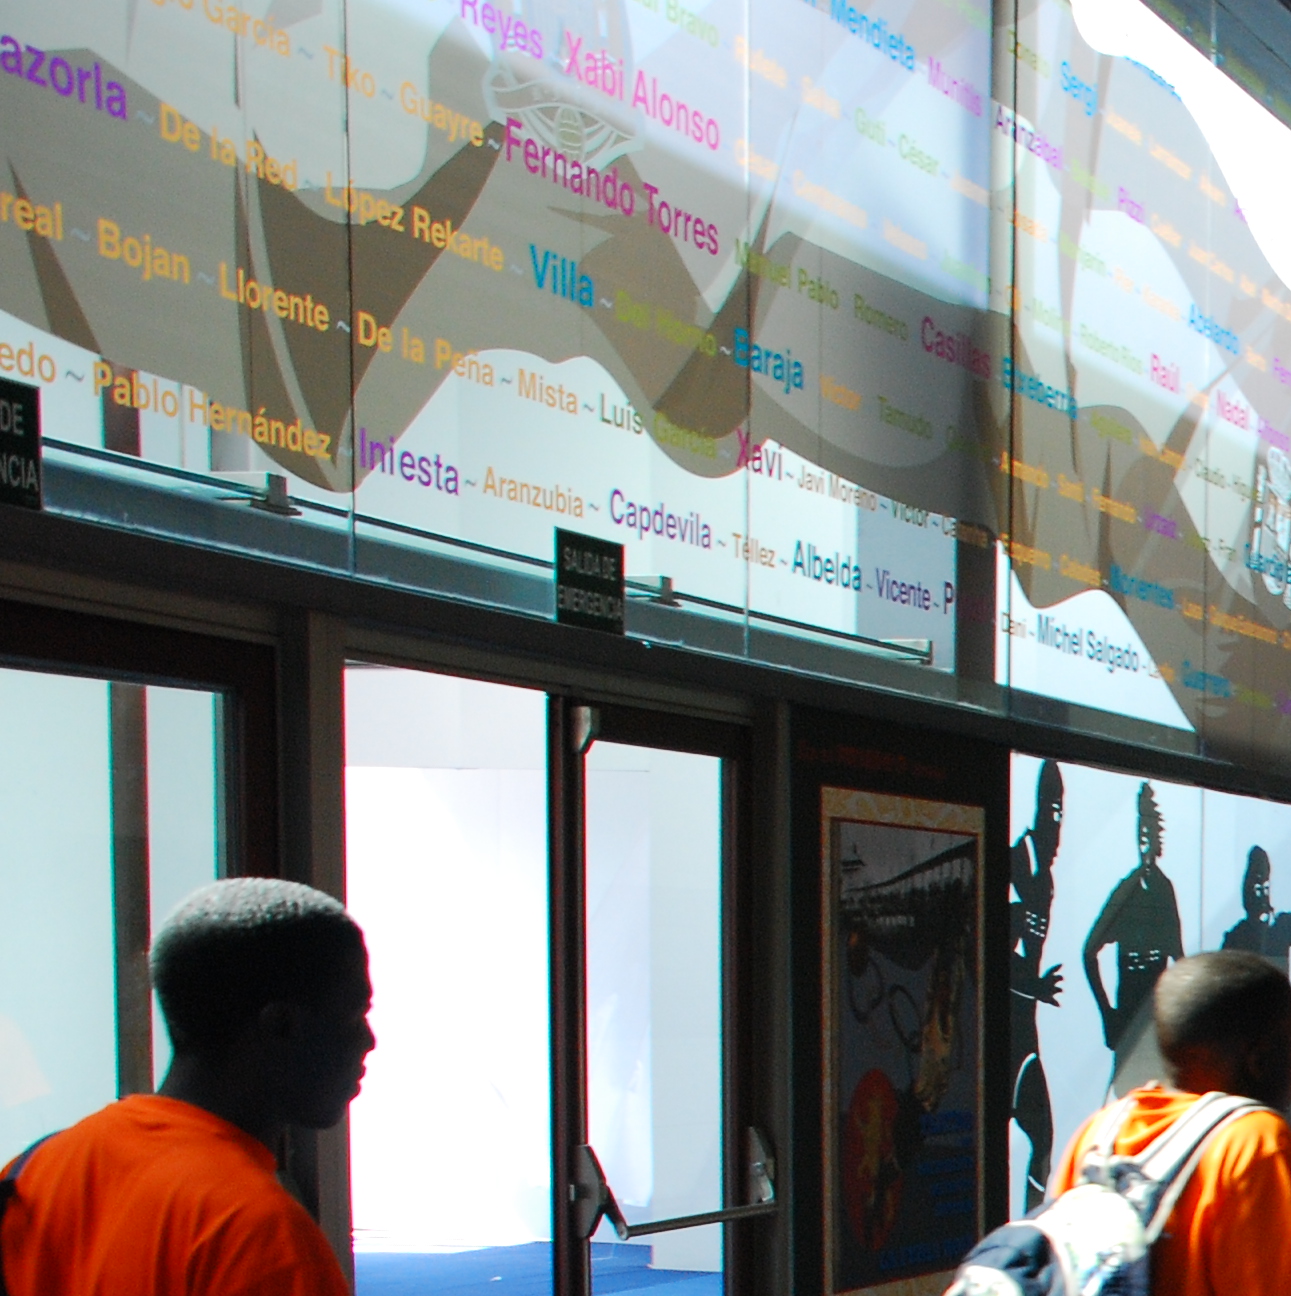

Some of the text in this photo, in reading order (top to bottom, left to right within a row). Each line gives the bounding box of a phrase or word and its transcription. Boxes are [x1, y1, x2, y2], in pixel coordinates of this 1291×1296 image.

[323, 46, 376, 98] Tiko
[401, 81, 485, 148] Guayre
[503, 117, 635, 217] Fernando
[643, 181, 719, 256] Torres
[565, 30, 624, 101] Xabi
[632, 69, 720, 151] Alonso
[0, 34, 127, 120] azorla
[160, 103, 200, 152] De
[209, 127, 237, 166] la
[246, 140, 298, 191] Red
[325, 172, 405, 233] López
[413, 206, 504, 271] Rekarte
[529, 244, 594, 308] Villa
[734, 326, 804, 395] Baraja
[97, 218, 191, 285] Bojan
[218, 262, 330, 334] Llorente
[357, 310, 392, 354] De
[402, 327, 425, 365] la
[434, 338, 495, 388] Peña
[518, 368, 578, 415] Mista
[600, 391, 644, 436] Luis
[0, 342, 57, 385] edo
[93, 360, 180, 418] Pablo
[188, 388, 332, 460] Hernández
[359, 427, 459, 496] Iniesta
[482, 466, 584, 518] Aranzubia
[609, 488, 712, 550] Capdevila
[731, 532, 776, 569] Téllez
[792, 540, 863, 593] Albelda
[876, 567, 931, 611] Vicente
[1037, 612, 1083, 657] Michel
[1087, 630, 1139, 674] Salgado
